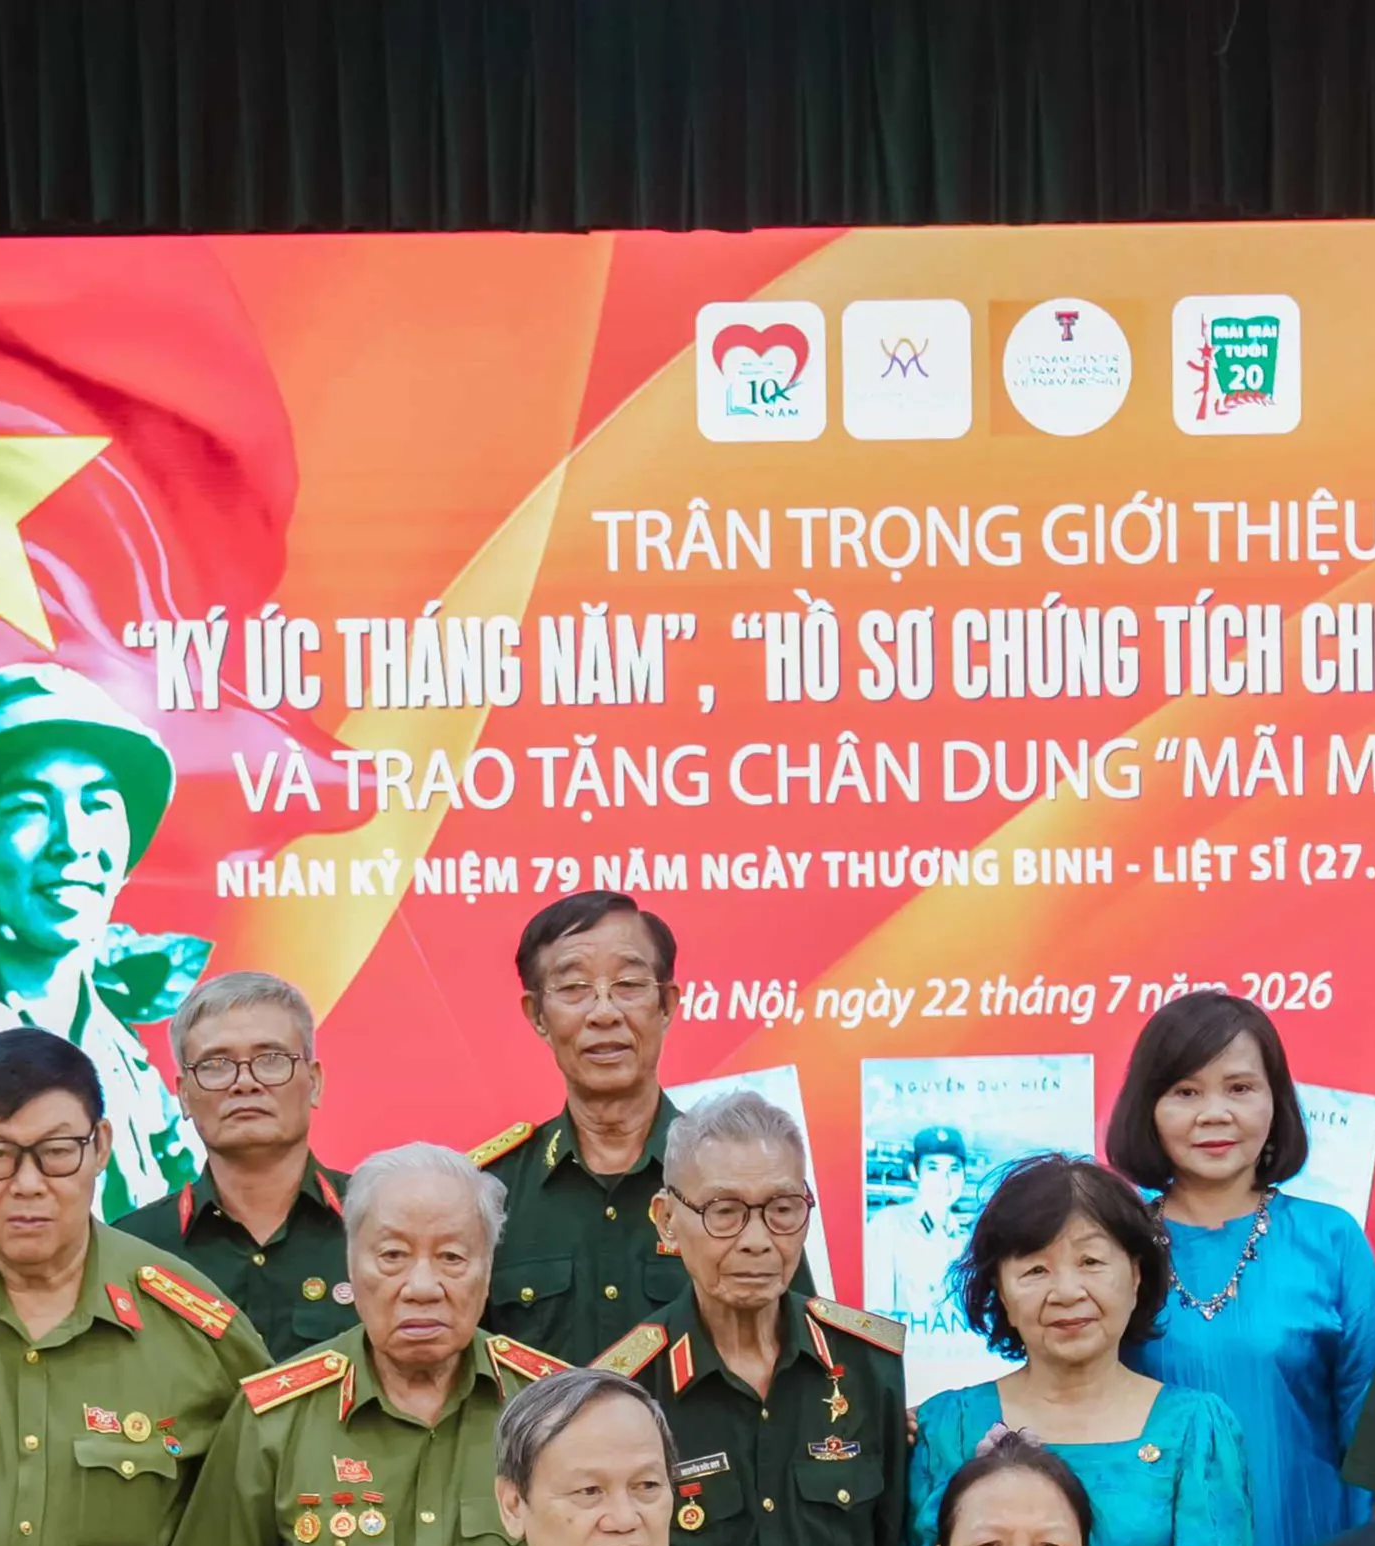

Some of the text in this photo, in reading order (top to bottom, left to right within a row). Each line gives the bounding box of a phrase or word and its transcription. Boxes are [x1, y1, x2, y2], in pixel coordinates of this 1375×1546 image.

[1228, 364, 1265, 391] 20
[592, 497, 770, 571] TRÂN
[787, 503, 1021, 582] TRỌNG
[1042, 491, 1177, 565] GIỚI
[246, 603, 321, 709] ỨC
[336, 600, 521, 709] THÁNG
[859, 606, 935, 700] SƠ
[952, 592, 1139, 699] CHỨNG
[1156, 588, 1281, 695] TÍCH
[232, 737, 321, 813] VÀ
[332, 748, 515, 810] TRAO
[527, 734, 709, 823] TẶNG
[730, 730, 920, 805] CHÂN
[943, 738, 1141, 801] DUNG
[216, 852, 336, 898] NHÂN
[348, 847, 401, 896] KỶ
[414, 850, 519, 904] NIỆM
[531, 857, 580, 893] 79
[593, 846, 688, 892] NĂM
[702, 846, 813, 891] NGÀY
[822, 846, 999, 889] THƯƠNG
[1013, 846, 1113, 886] BINH
[1127, 864, 1139, 872] -
[1153, 838, 1238, 891] LIỆT
[1249, 836, 1288, 882] SĨ
[728, 979, 805, 1029] Nội,
[815, 979, 916, 1028] ngày
[921, 979, 971, 1017] 22
[980, 975, 1097, 1025] tháng
[1108, 975, 1132, 1013] 7
[1241, 971, 1333, 1012] 2026
